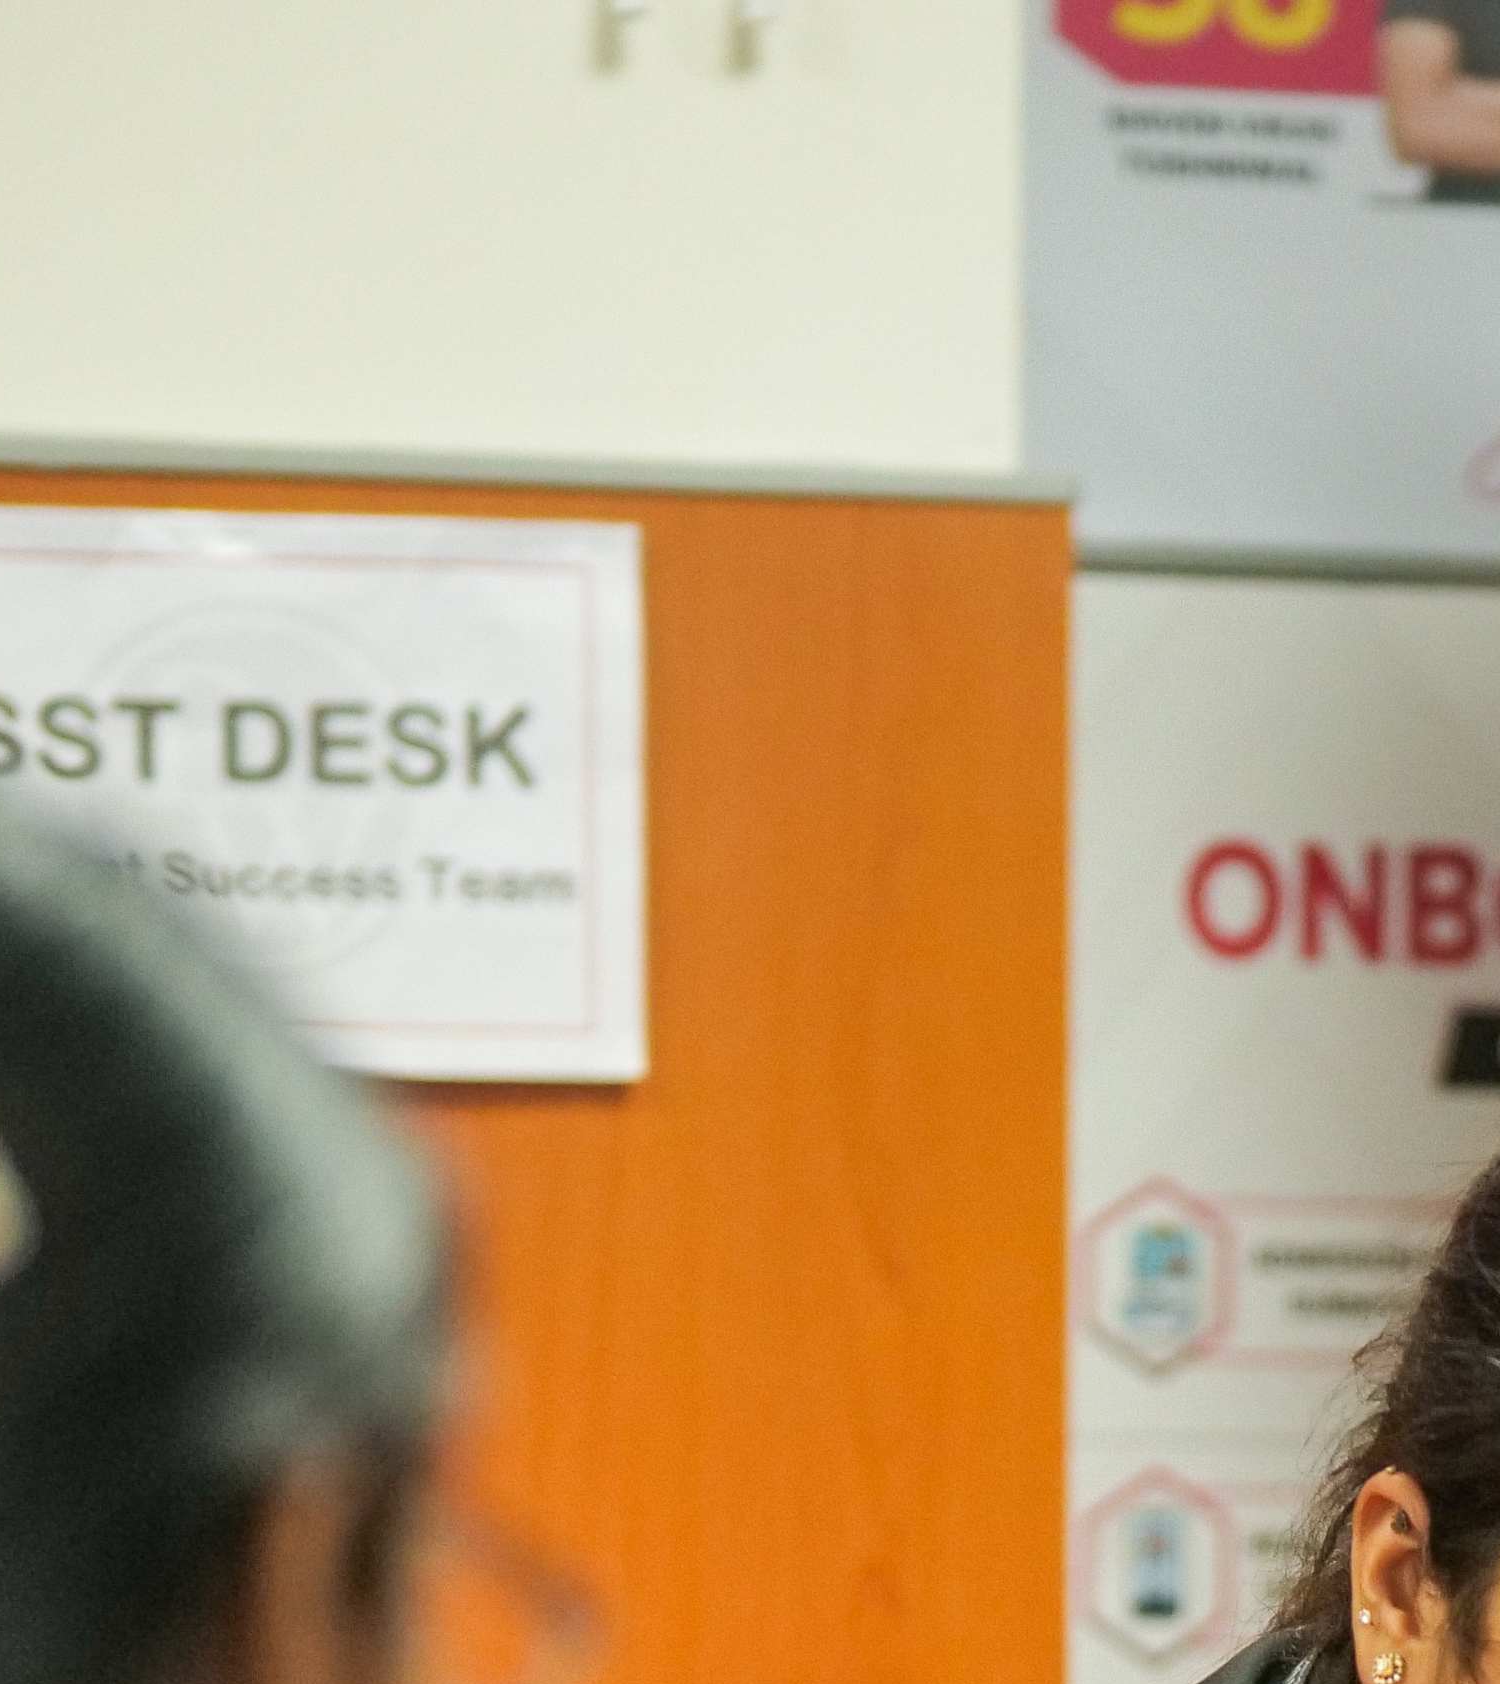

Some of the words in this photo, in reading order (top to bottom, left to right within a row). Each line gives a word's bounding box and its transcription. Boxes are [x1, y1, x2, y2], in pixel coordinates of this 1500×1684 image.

[221, 700, 536, 790] DESK
[160, 850, 402, 904] Success
[418, 856, 578, 904] Team
